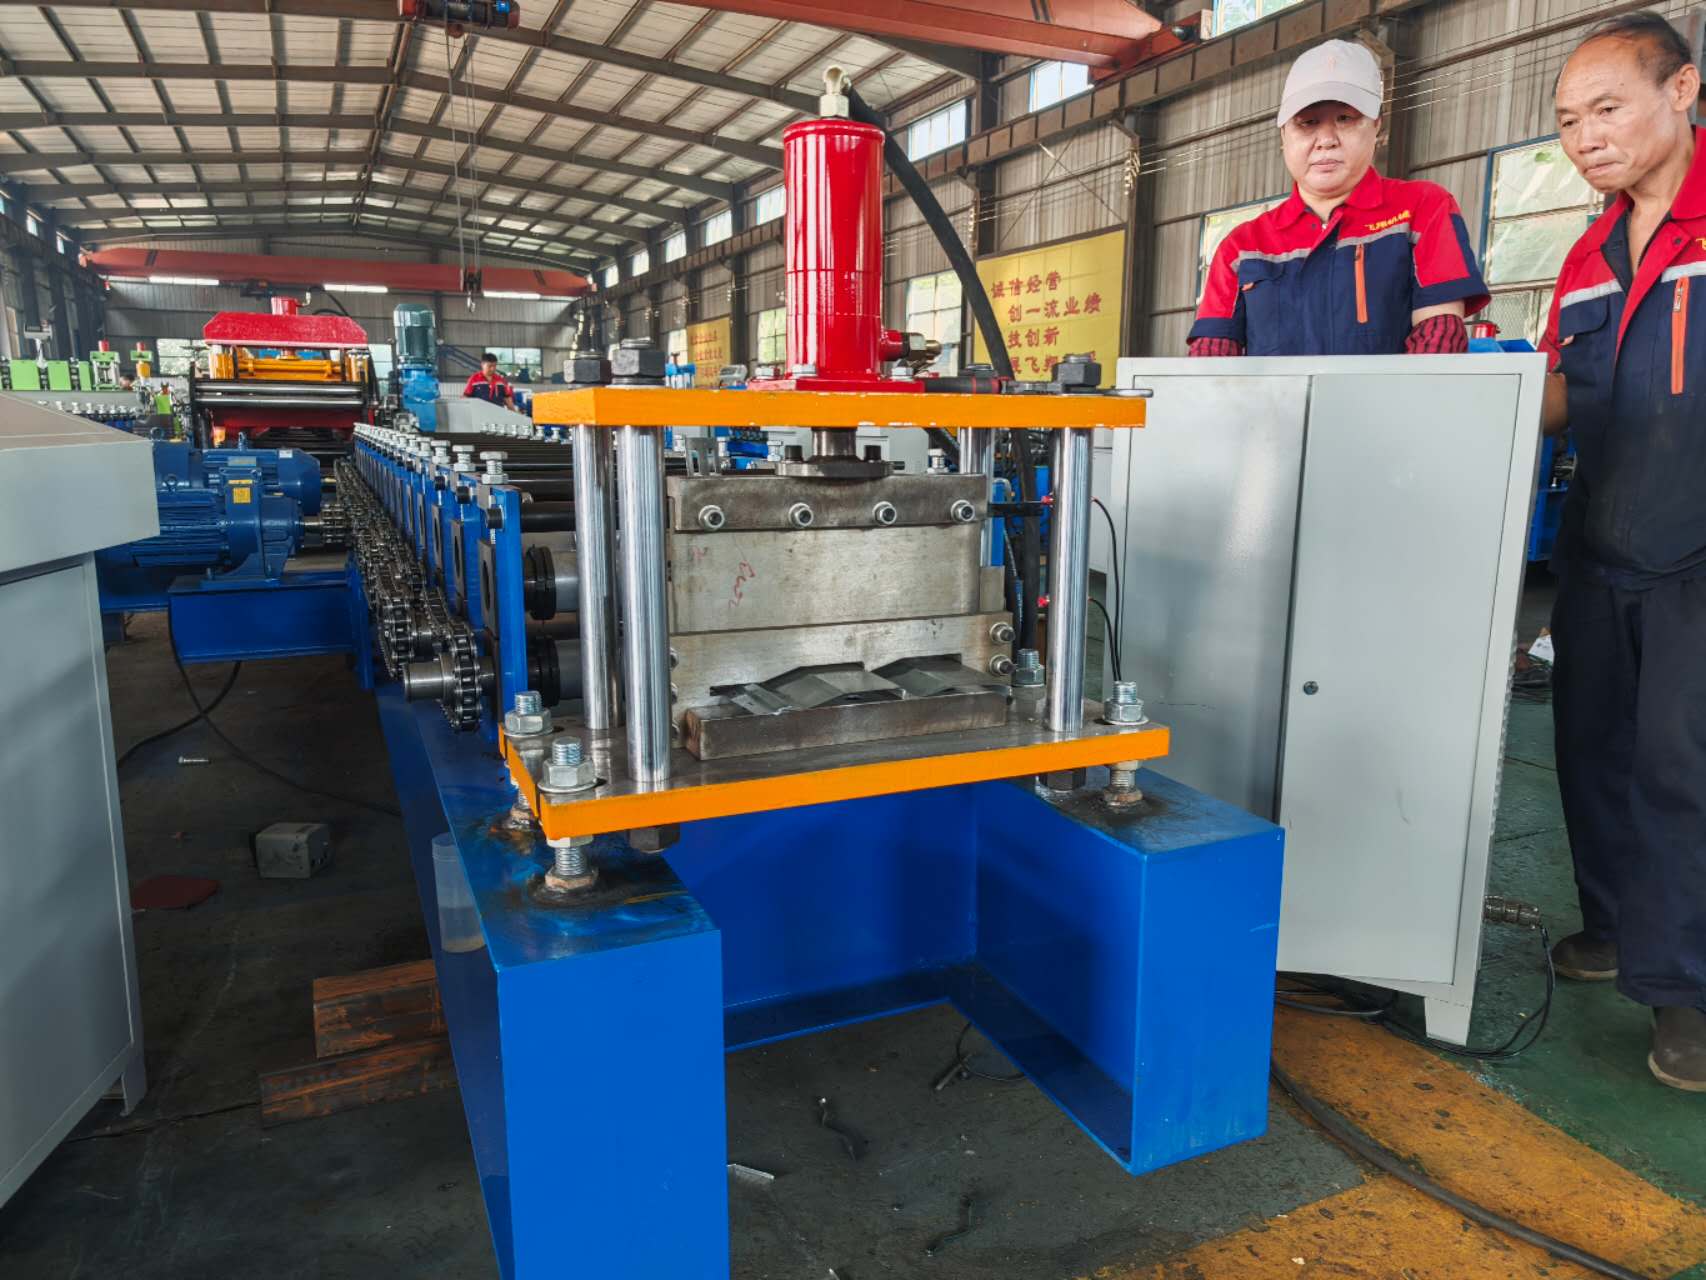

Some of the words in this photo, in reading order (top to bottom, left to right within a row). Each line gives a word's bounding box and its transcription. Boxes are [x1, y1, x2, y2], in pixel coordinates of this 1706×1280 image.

[991, 270, 1061, 298] 诚信经营
[1008, 292, 1101, 323] 创一流业绩
